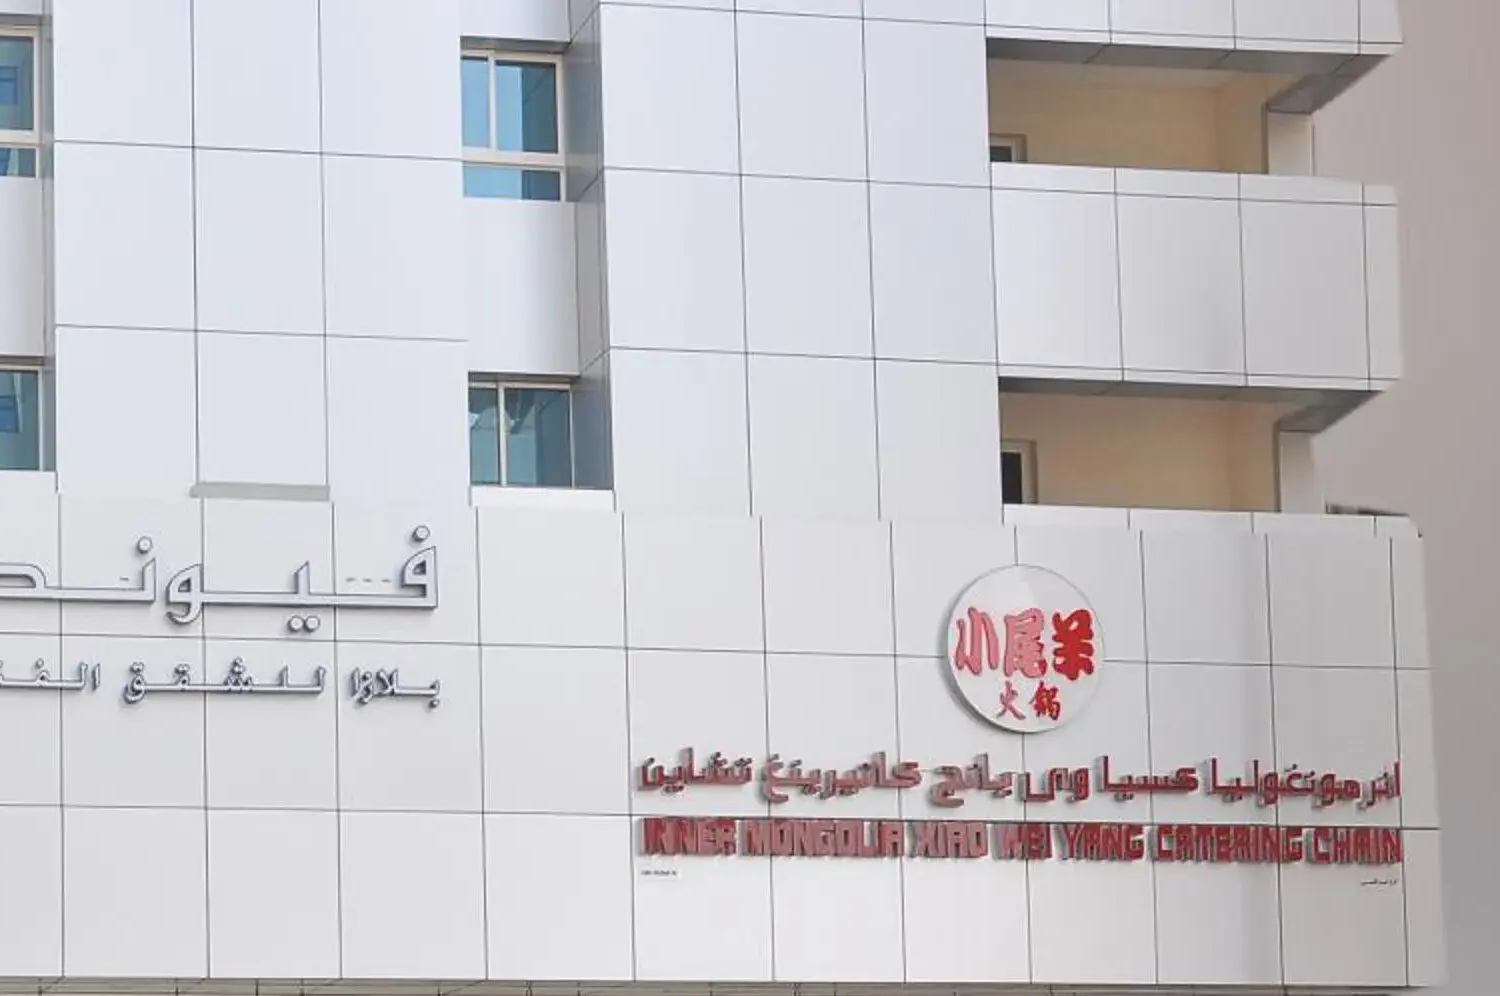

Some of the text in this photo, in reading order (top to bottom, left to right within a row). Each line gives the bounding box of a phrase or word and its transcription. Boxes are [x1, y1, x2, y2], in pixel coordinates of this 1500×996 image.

[955, 606, 1095, 681] 小尾羊
[121, 656, 328, 704] للشقق
[350, 666, 441, 709] بلازا
[641, 817, 1403, 864] INNER MONGOLIA XIAO WEI YANG CATERING CHAIN
